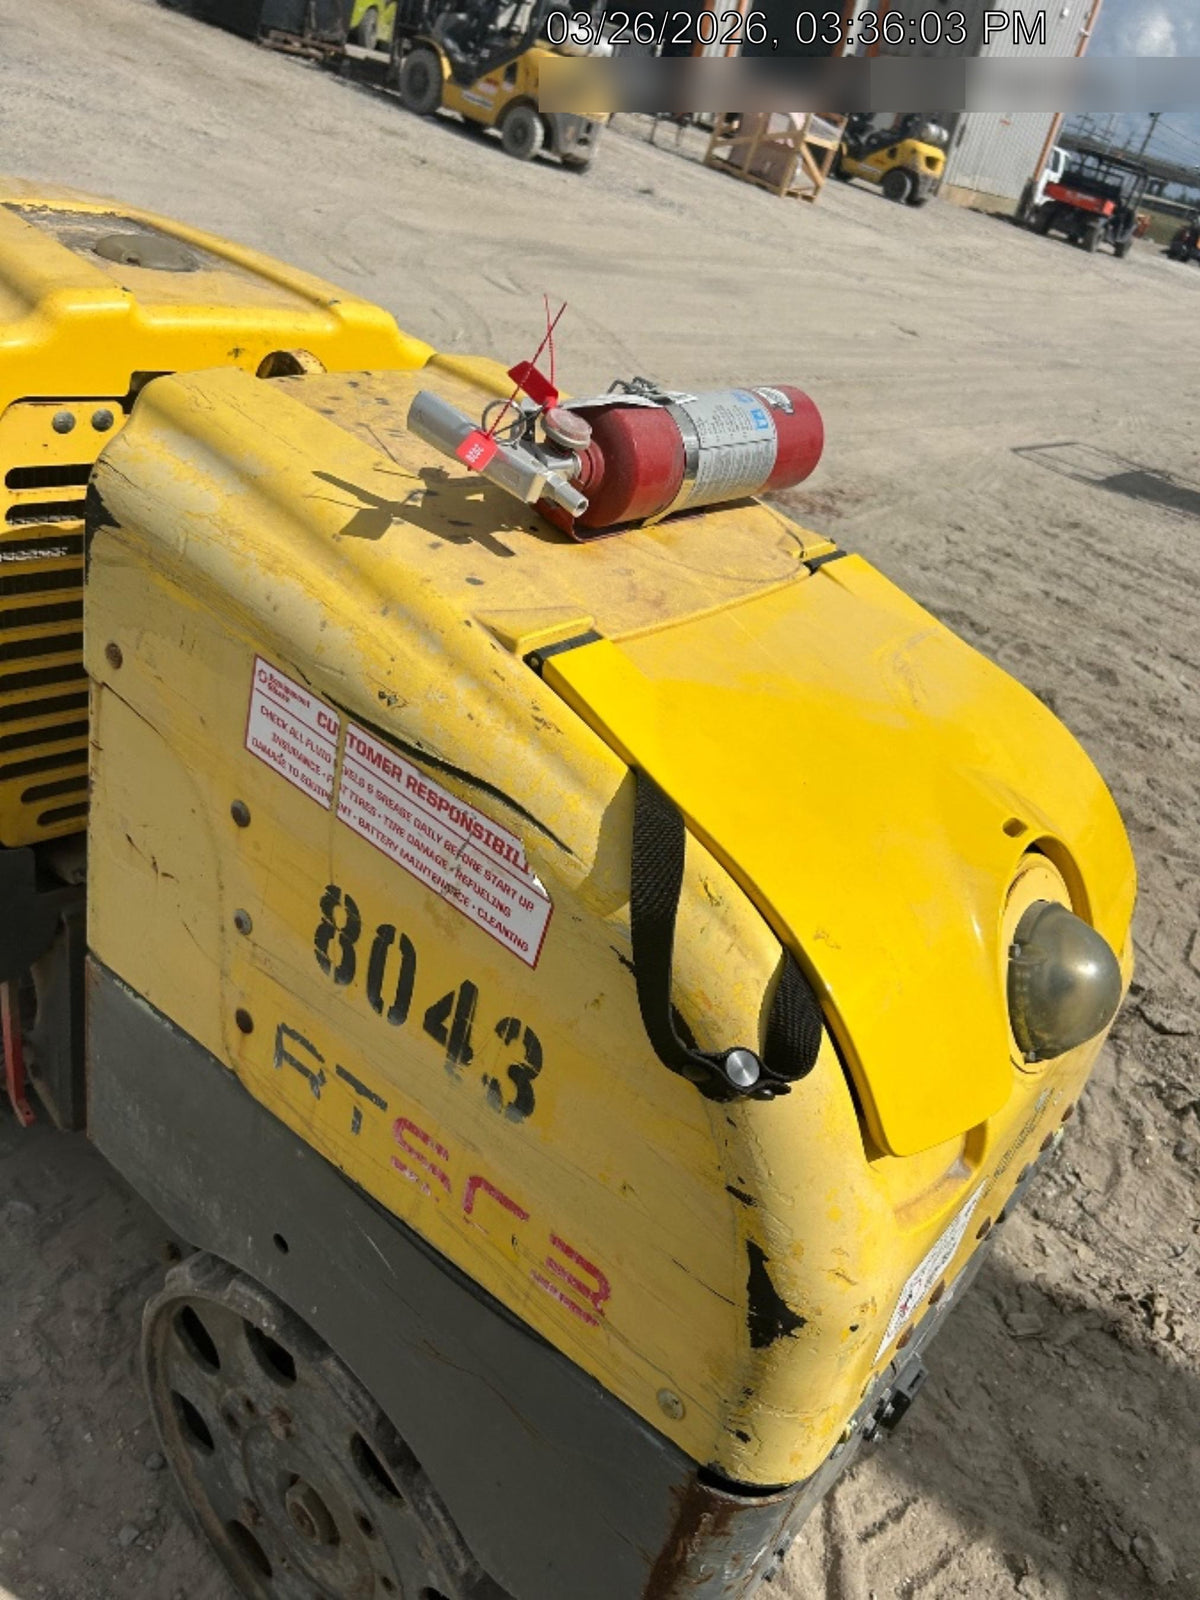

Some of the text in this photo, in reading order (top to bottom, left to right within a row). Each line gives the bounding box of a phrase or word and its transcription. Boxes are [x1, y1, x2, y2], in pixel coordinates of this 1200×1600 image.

[261, 705, 287, 730] CHECK
[289, 726, 302, 741] ALL
[413, 817, 442, 844] DAILY
[444, 840, 482, 873] BEFORE
[483, 869, 517, 898] START
[518, 895, 534, 911] UP
[316, 710, 402, 781] CUTOMER
[288, 764, 298, 776] TO
[358, 816, 397, 851] BATTERY
[477, 907, 529, 951] CLEANING
[349, 790, 376, 815] TIRES
[383, 815, 405, 836] TIRE
[407, 833, 447, 868] DAMAGE
[455, 869, 512, 916] REFUELING
[314, 884, 542, 1123] 8043
